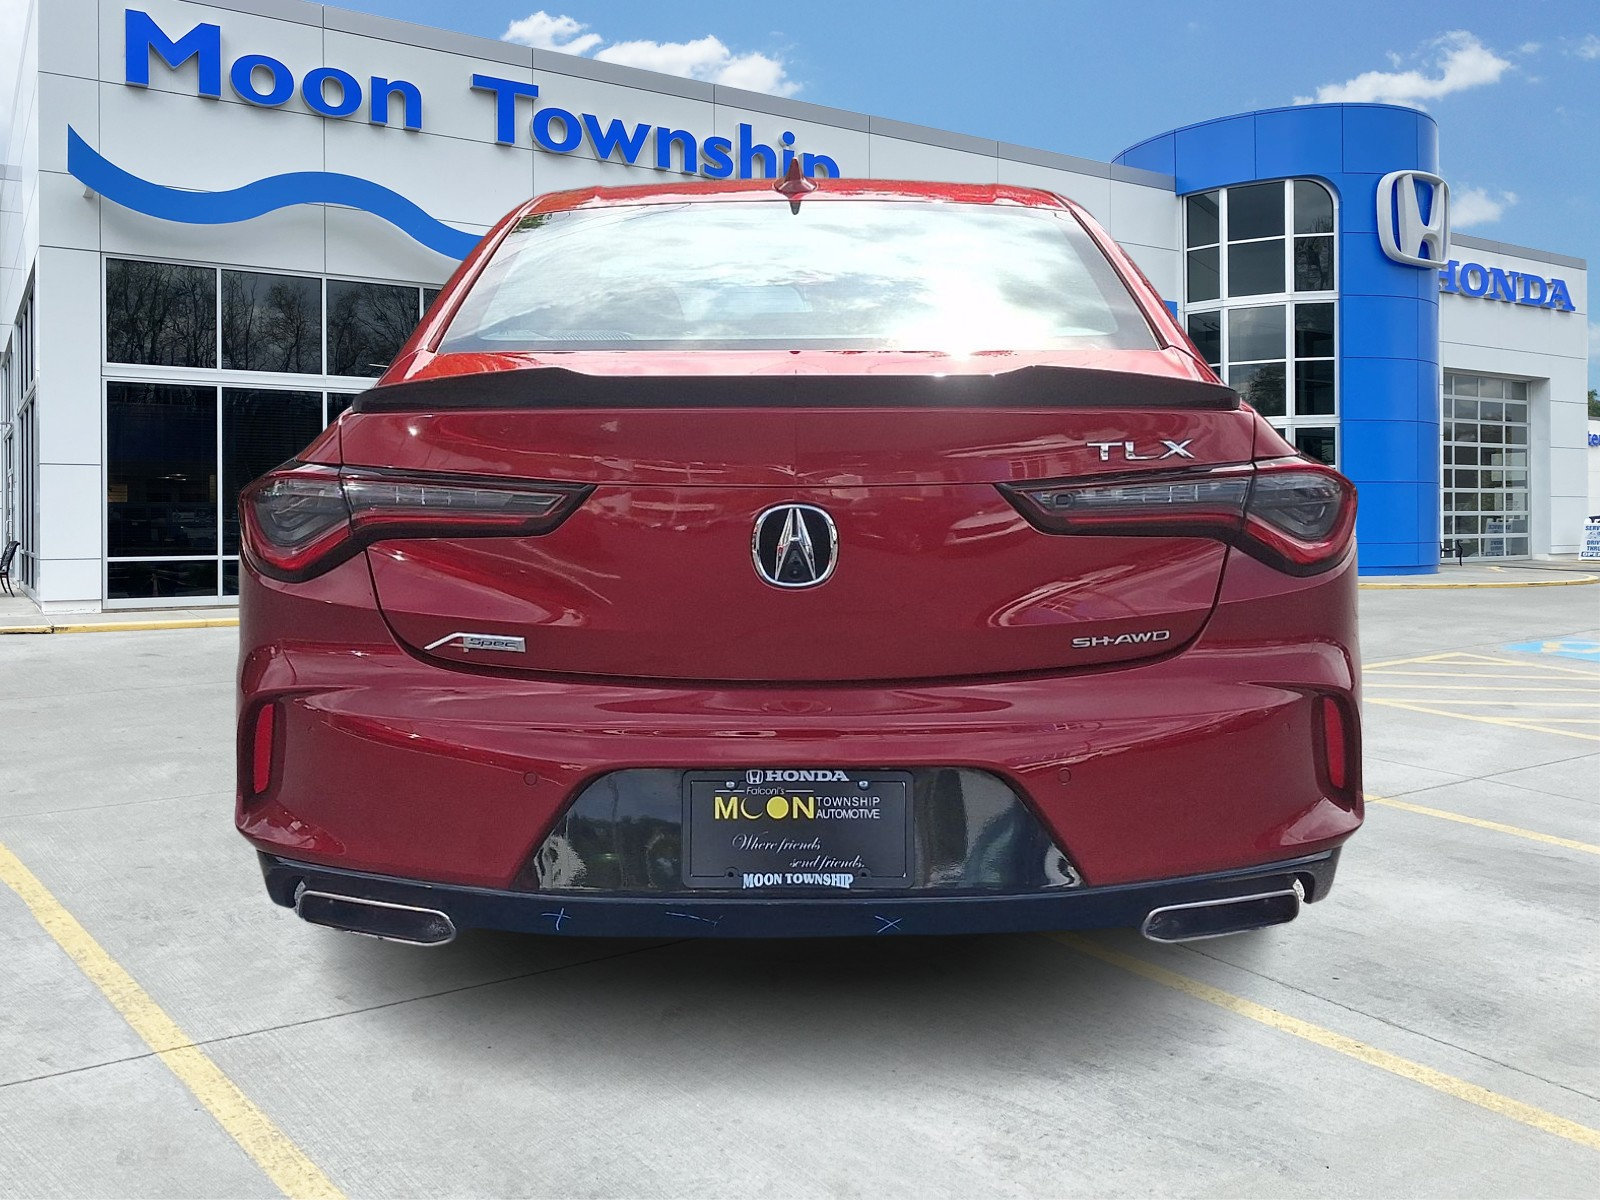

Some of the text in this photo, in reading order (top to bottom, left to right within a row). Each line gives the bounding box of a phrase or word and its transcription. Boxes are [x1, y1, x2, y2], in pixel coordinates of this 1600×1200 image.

[124, 8, 422, 131] Moon
[1438, 259, 1577, 313] HONDA
[1086, 438, 1196, 461] TLX
[1071, 630, 1170, 648] SH-AWD
[766, 770, 850, 782] HONDA
[746, 787, 785, 795] Falconi's
[816, 797, 880, 807] TOWNSHIP
[816, 809, 880, 819] AUTOMOTIVE
[732, 831, 822, 853] Where friends
[789, 855, 821, 868] send
[743, 873, 854, 889] MOON TOWNSHIP
